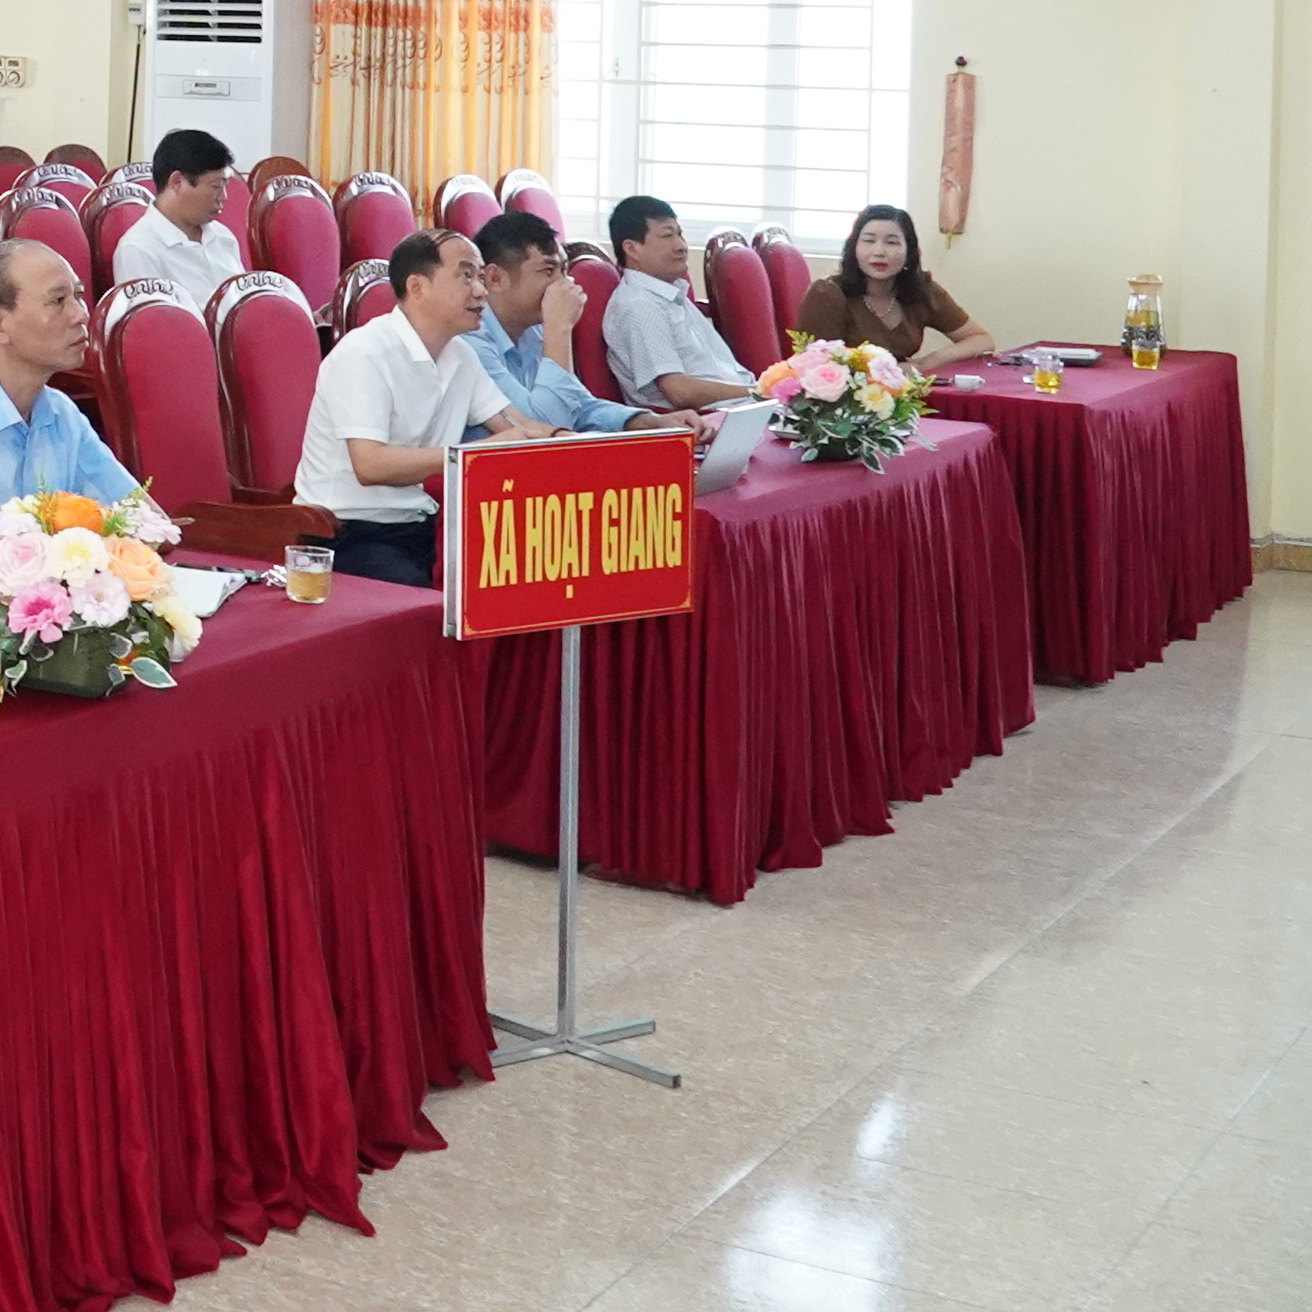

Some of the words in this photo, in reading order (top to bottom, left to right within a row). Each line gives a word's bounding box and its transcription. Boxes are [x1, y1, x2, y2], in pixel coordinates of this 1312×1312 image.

[478, 478, 518, 589] XÃ
[525, 491, 594, 598] HOẠT
[601, 483, 683, 576] GIANG
